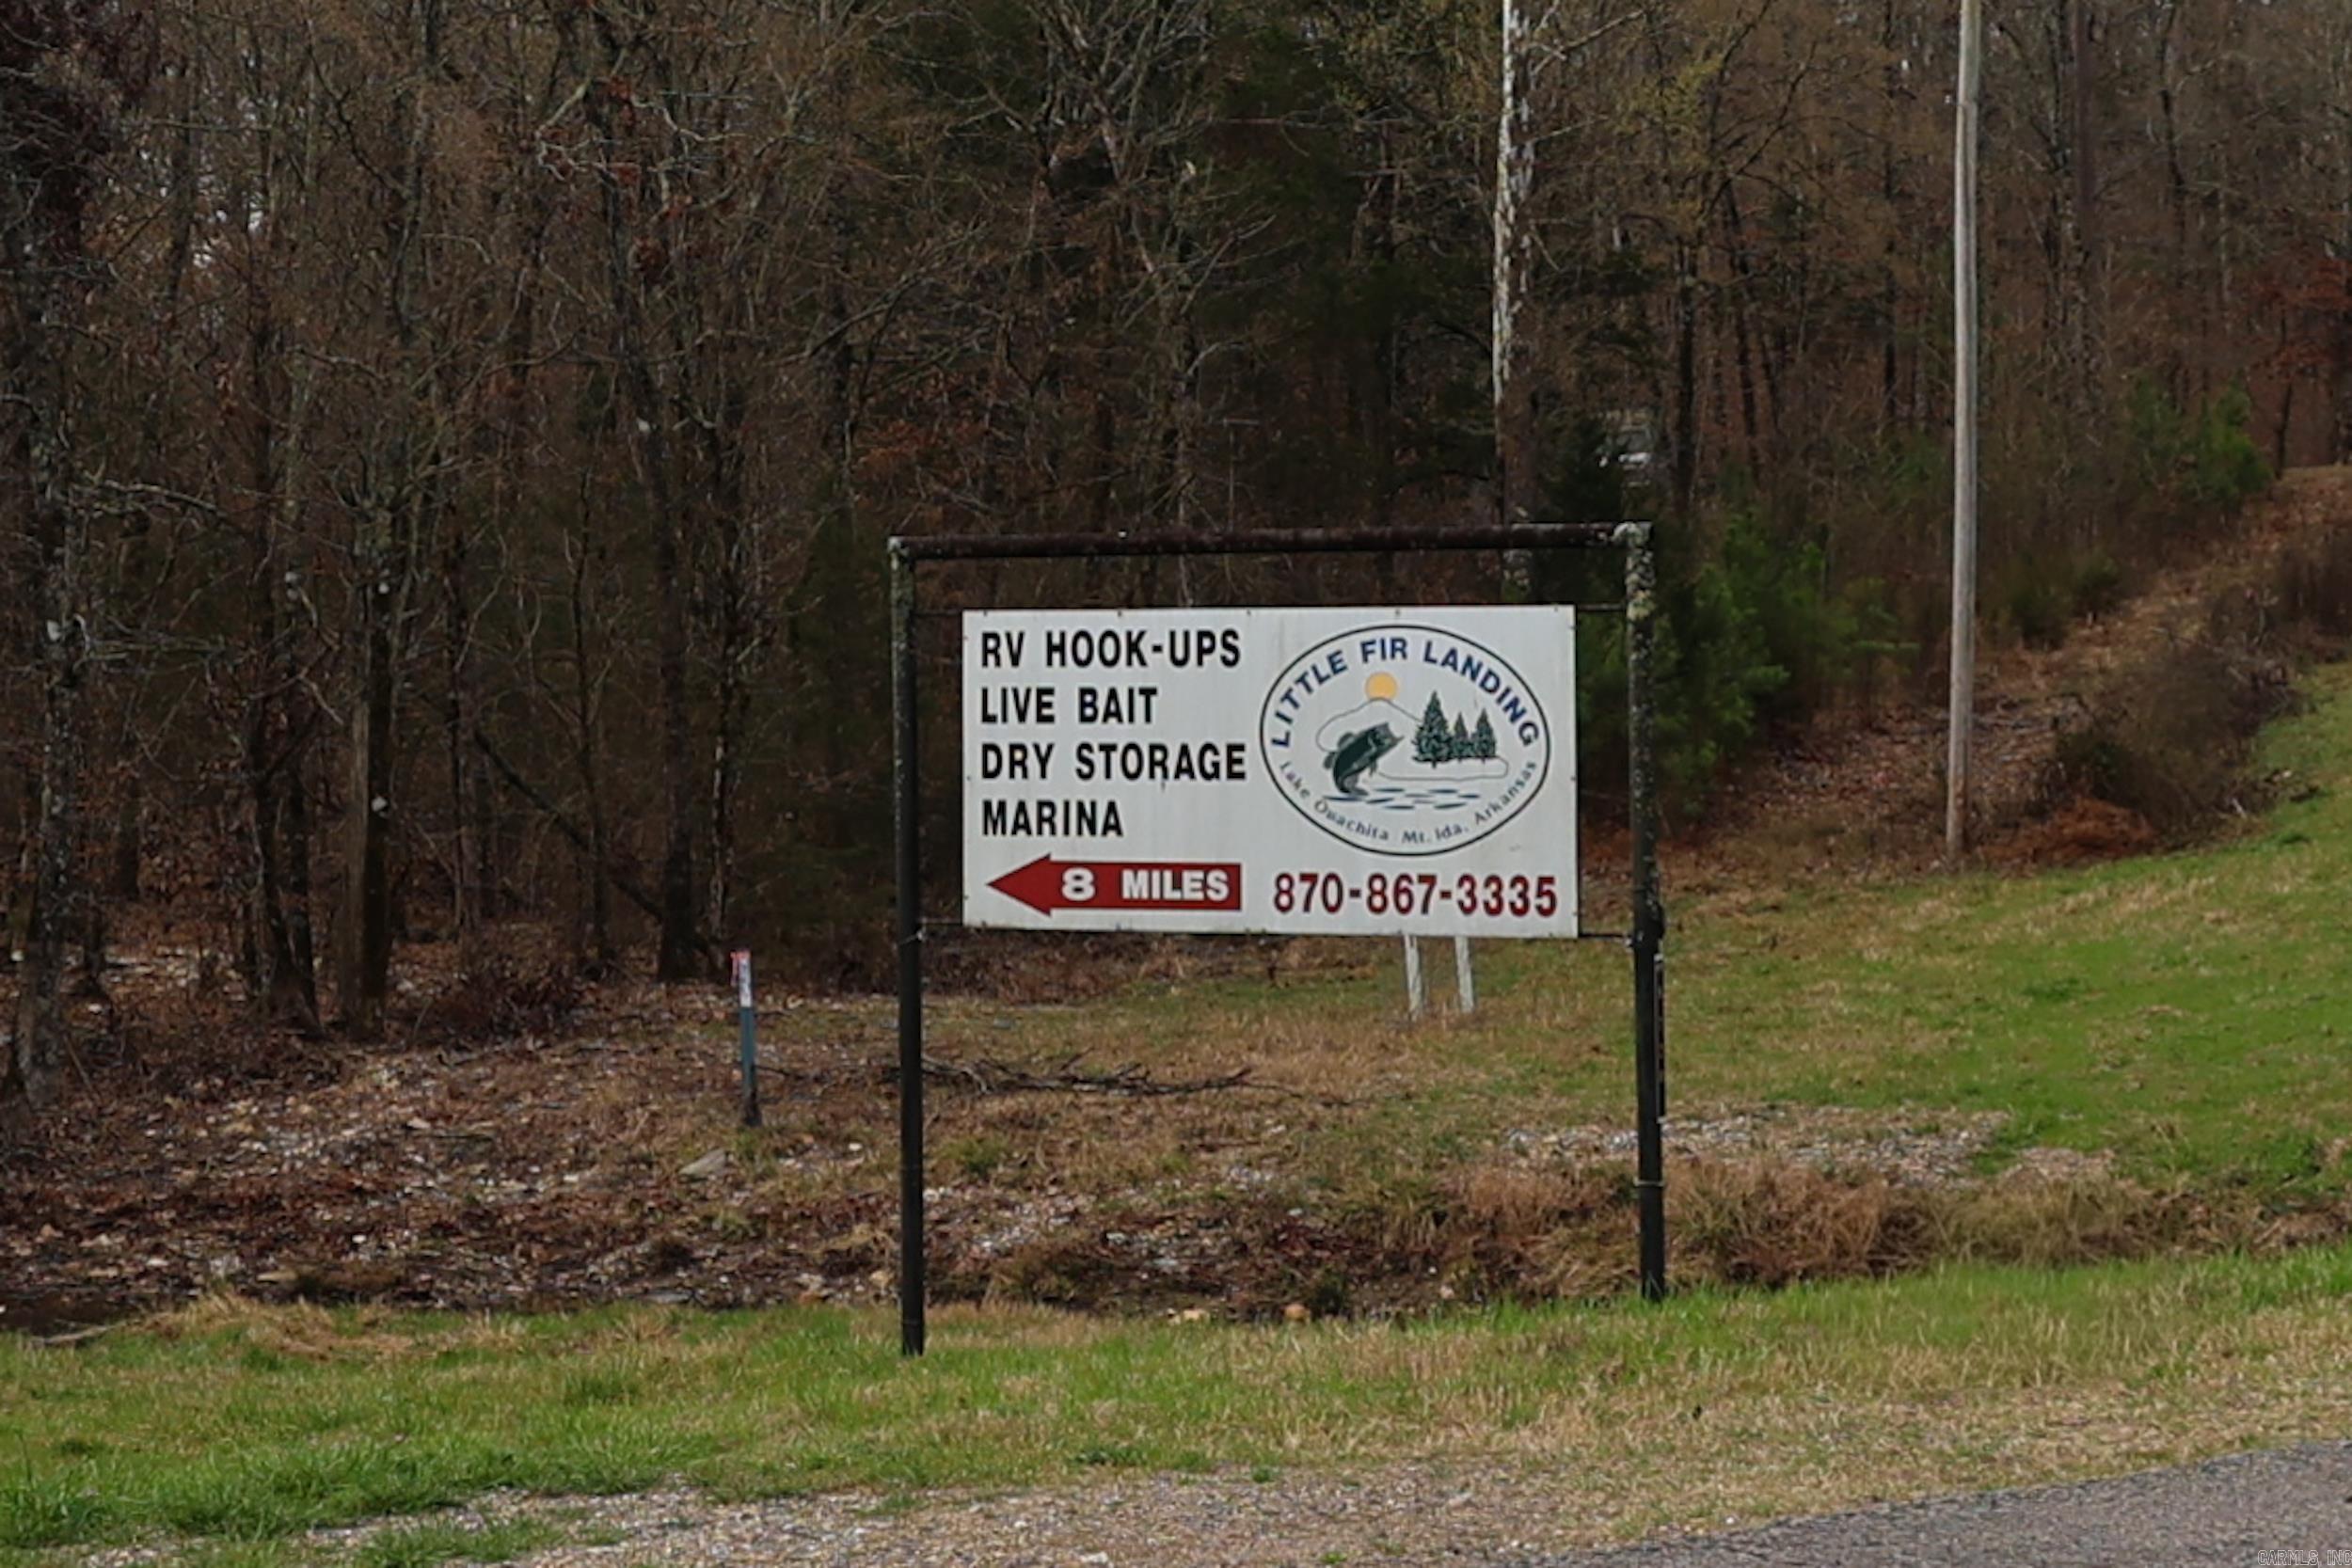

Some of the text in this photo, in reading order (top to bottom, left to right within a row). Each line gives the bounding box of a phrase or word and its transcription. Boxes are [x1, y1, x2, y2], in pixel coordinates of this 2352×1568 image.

[981, 629, 1241, 668] RV HOOK-UPS
[981, 687, 1158, 724] LIVE BAIT
[1271, 637, 1540, 749] LITTLE FIR LANDING
[981, 742, 1248, 780] DRY STORAGE
[981, 800, 1124, 837] MARINA
[1279, 761, 1311, 800] Lake
[1313, 800, 1390, 841] Ouachita
[1473, 761, 1537, 826] Arkansas
[1061, 867, 1230, 902] 8 MILES
[1273, 872, 1558, 918] 870-867-3335
